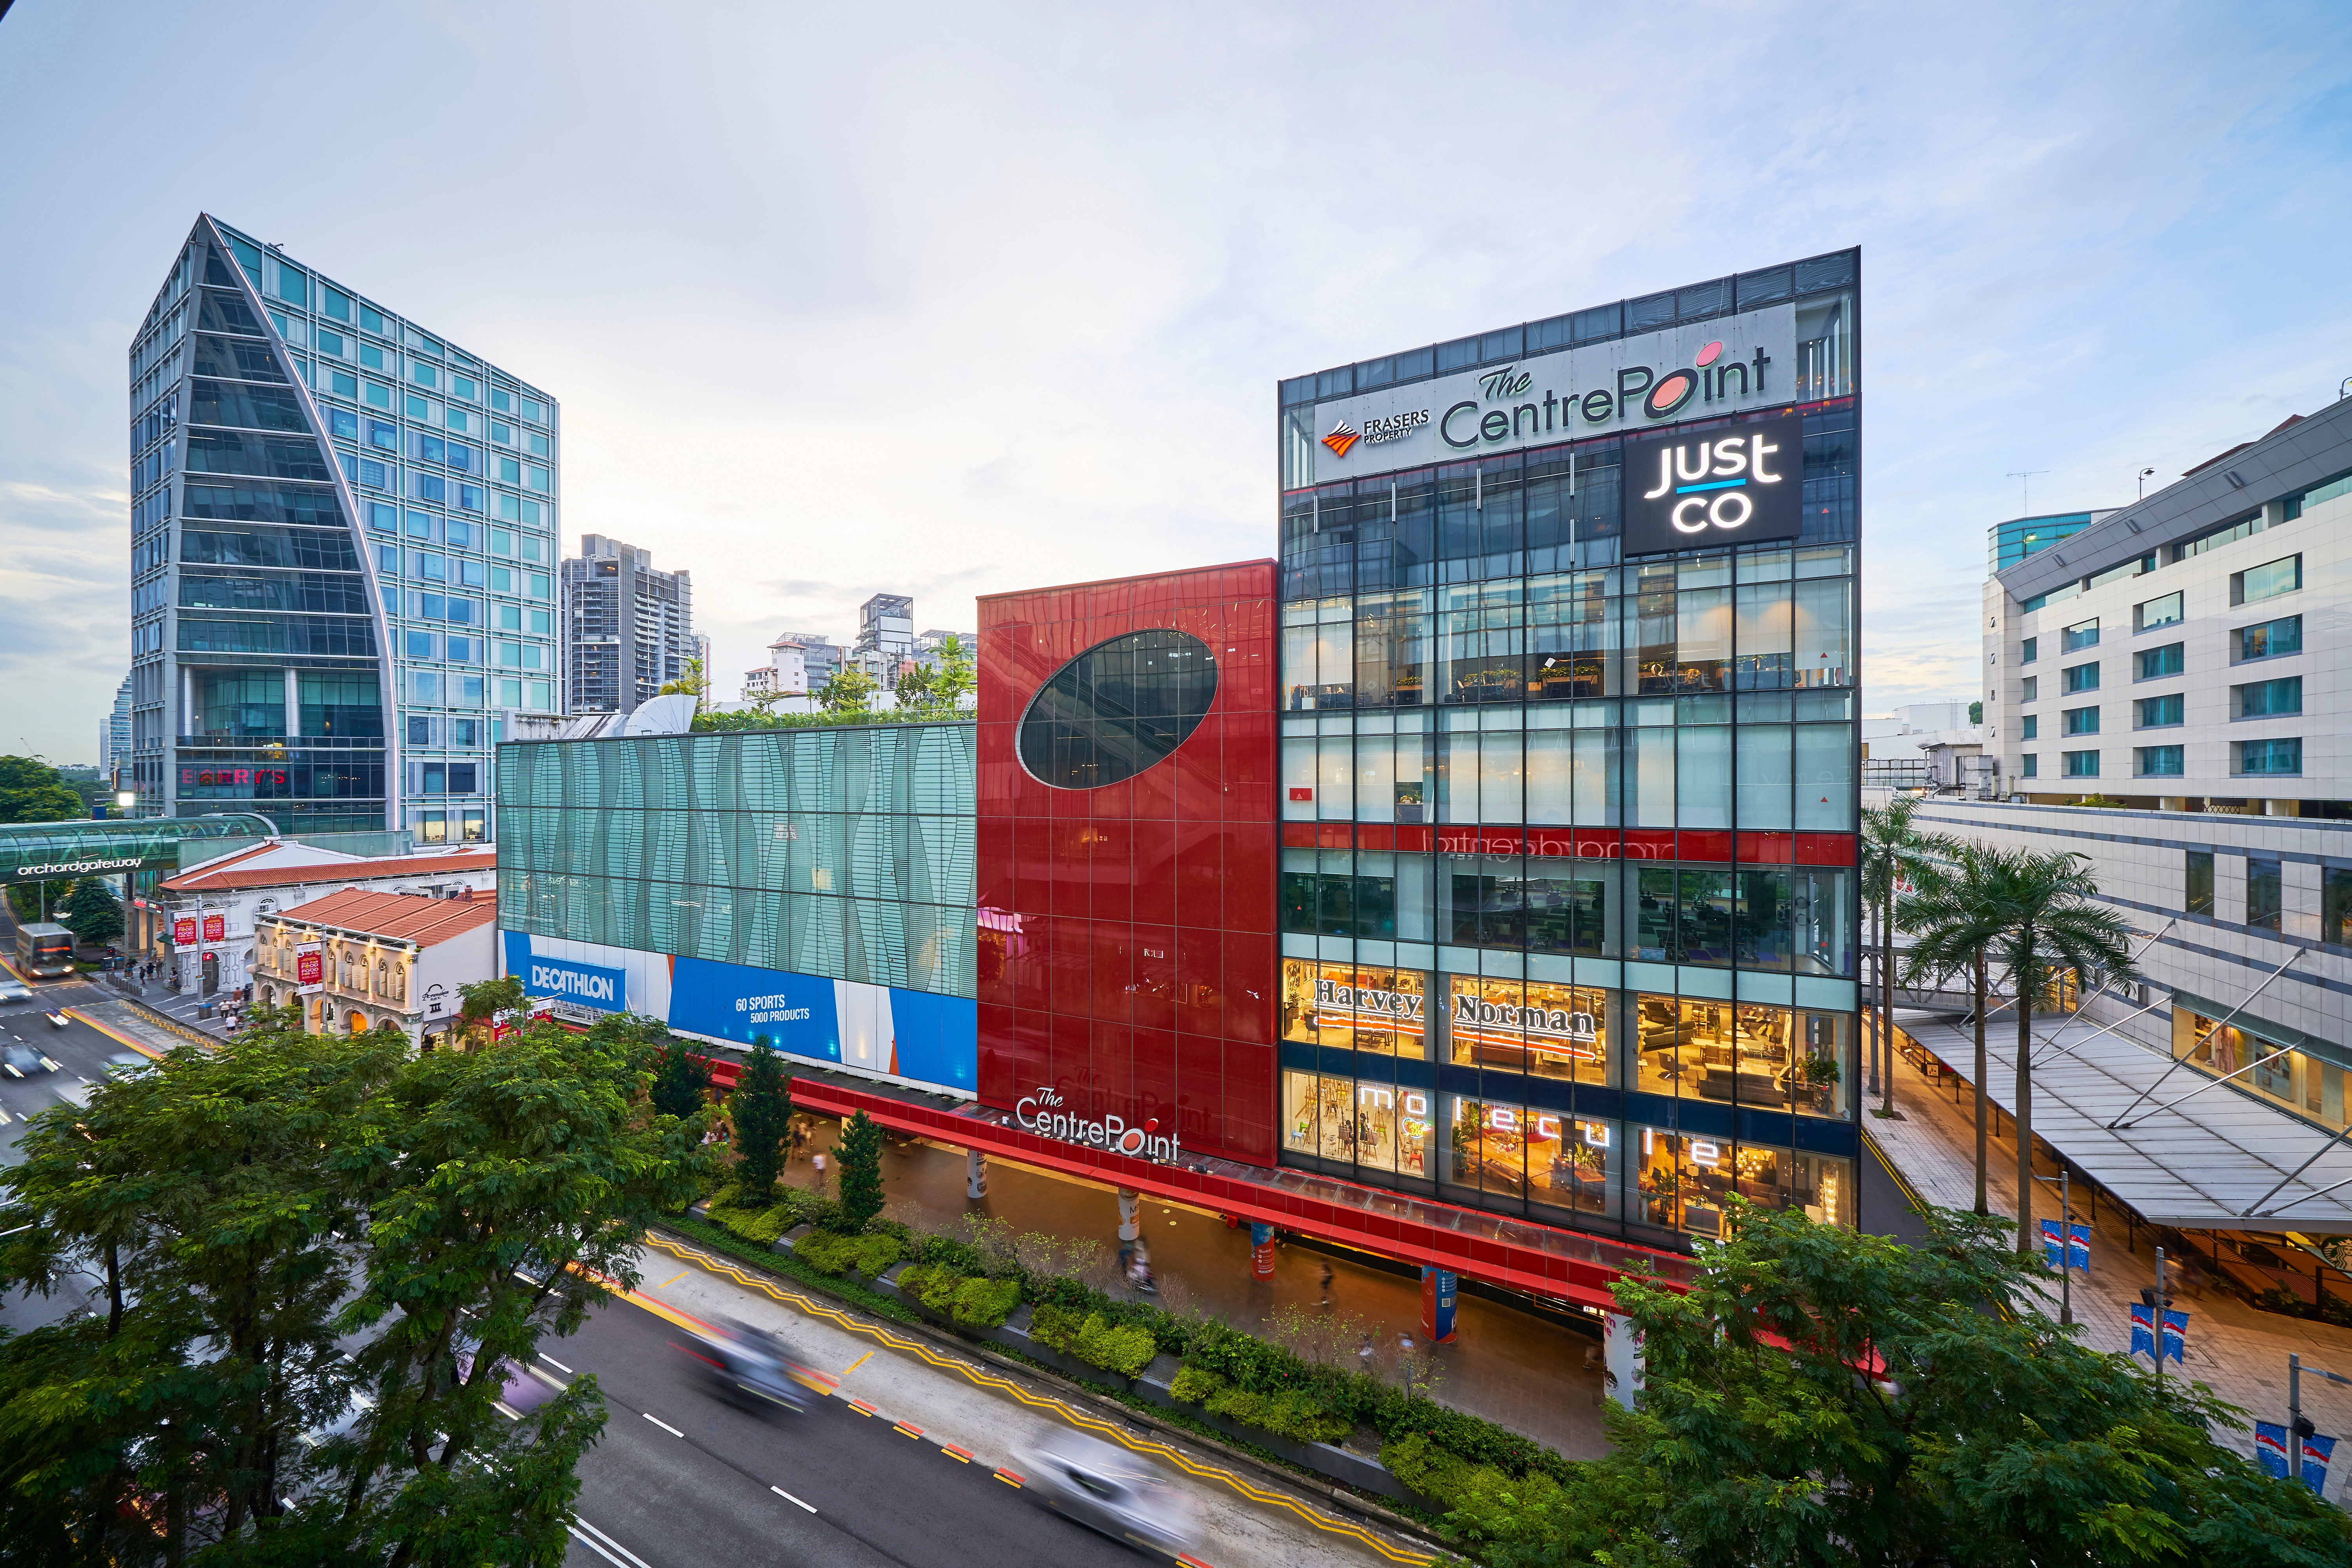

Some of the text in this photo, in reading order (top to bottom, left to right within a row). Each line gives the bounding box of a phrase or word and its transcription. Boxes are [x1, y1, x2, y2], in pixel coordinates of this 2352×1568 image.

[1441, 341, 1771, 448] CentrePoint
[1479, 365, 1532, 400] The
[1364, 409, 1429, 434] FRASERS
[1364, 427, 1411, 445] PROPERTY
[18, 858, 142, 875] orchardgateway
[532, 965, 613, 1001] DECATHLON
[736, 994, 785, 1012] 60 SPORTS
[1314, 979, 1423, 1019] Harvey
[751, 1008, 809, 1024] 5000 PRODUCTS
[1455, 994, 1595, 1036] Norman
[1036, 1087, 1063, 1108] The
[1016, 1097, 1180, 1161] CentrePoint
[1410, 1129, 1423, 1137] JAM
